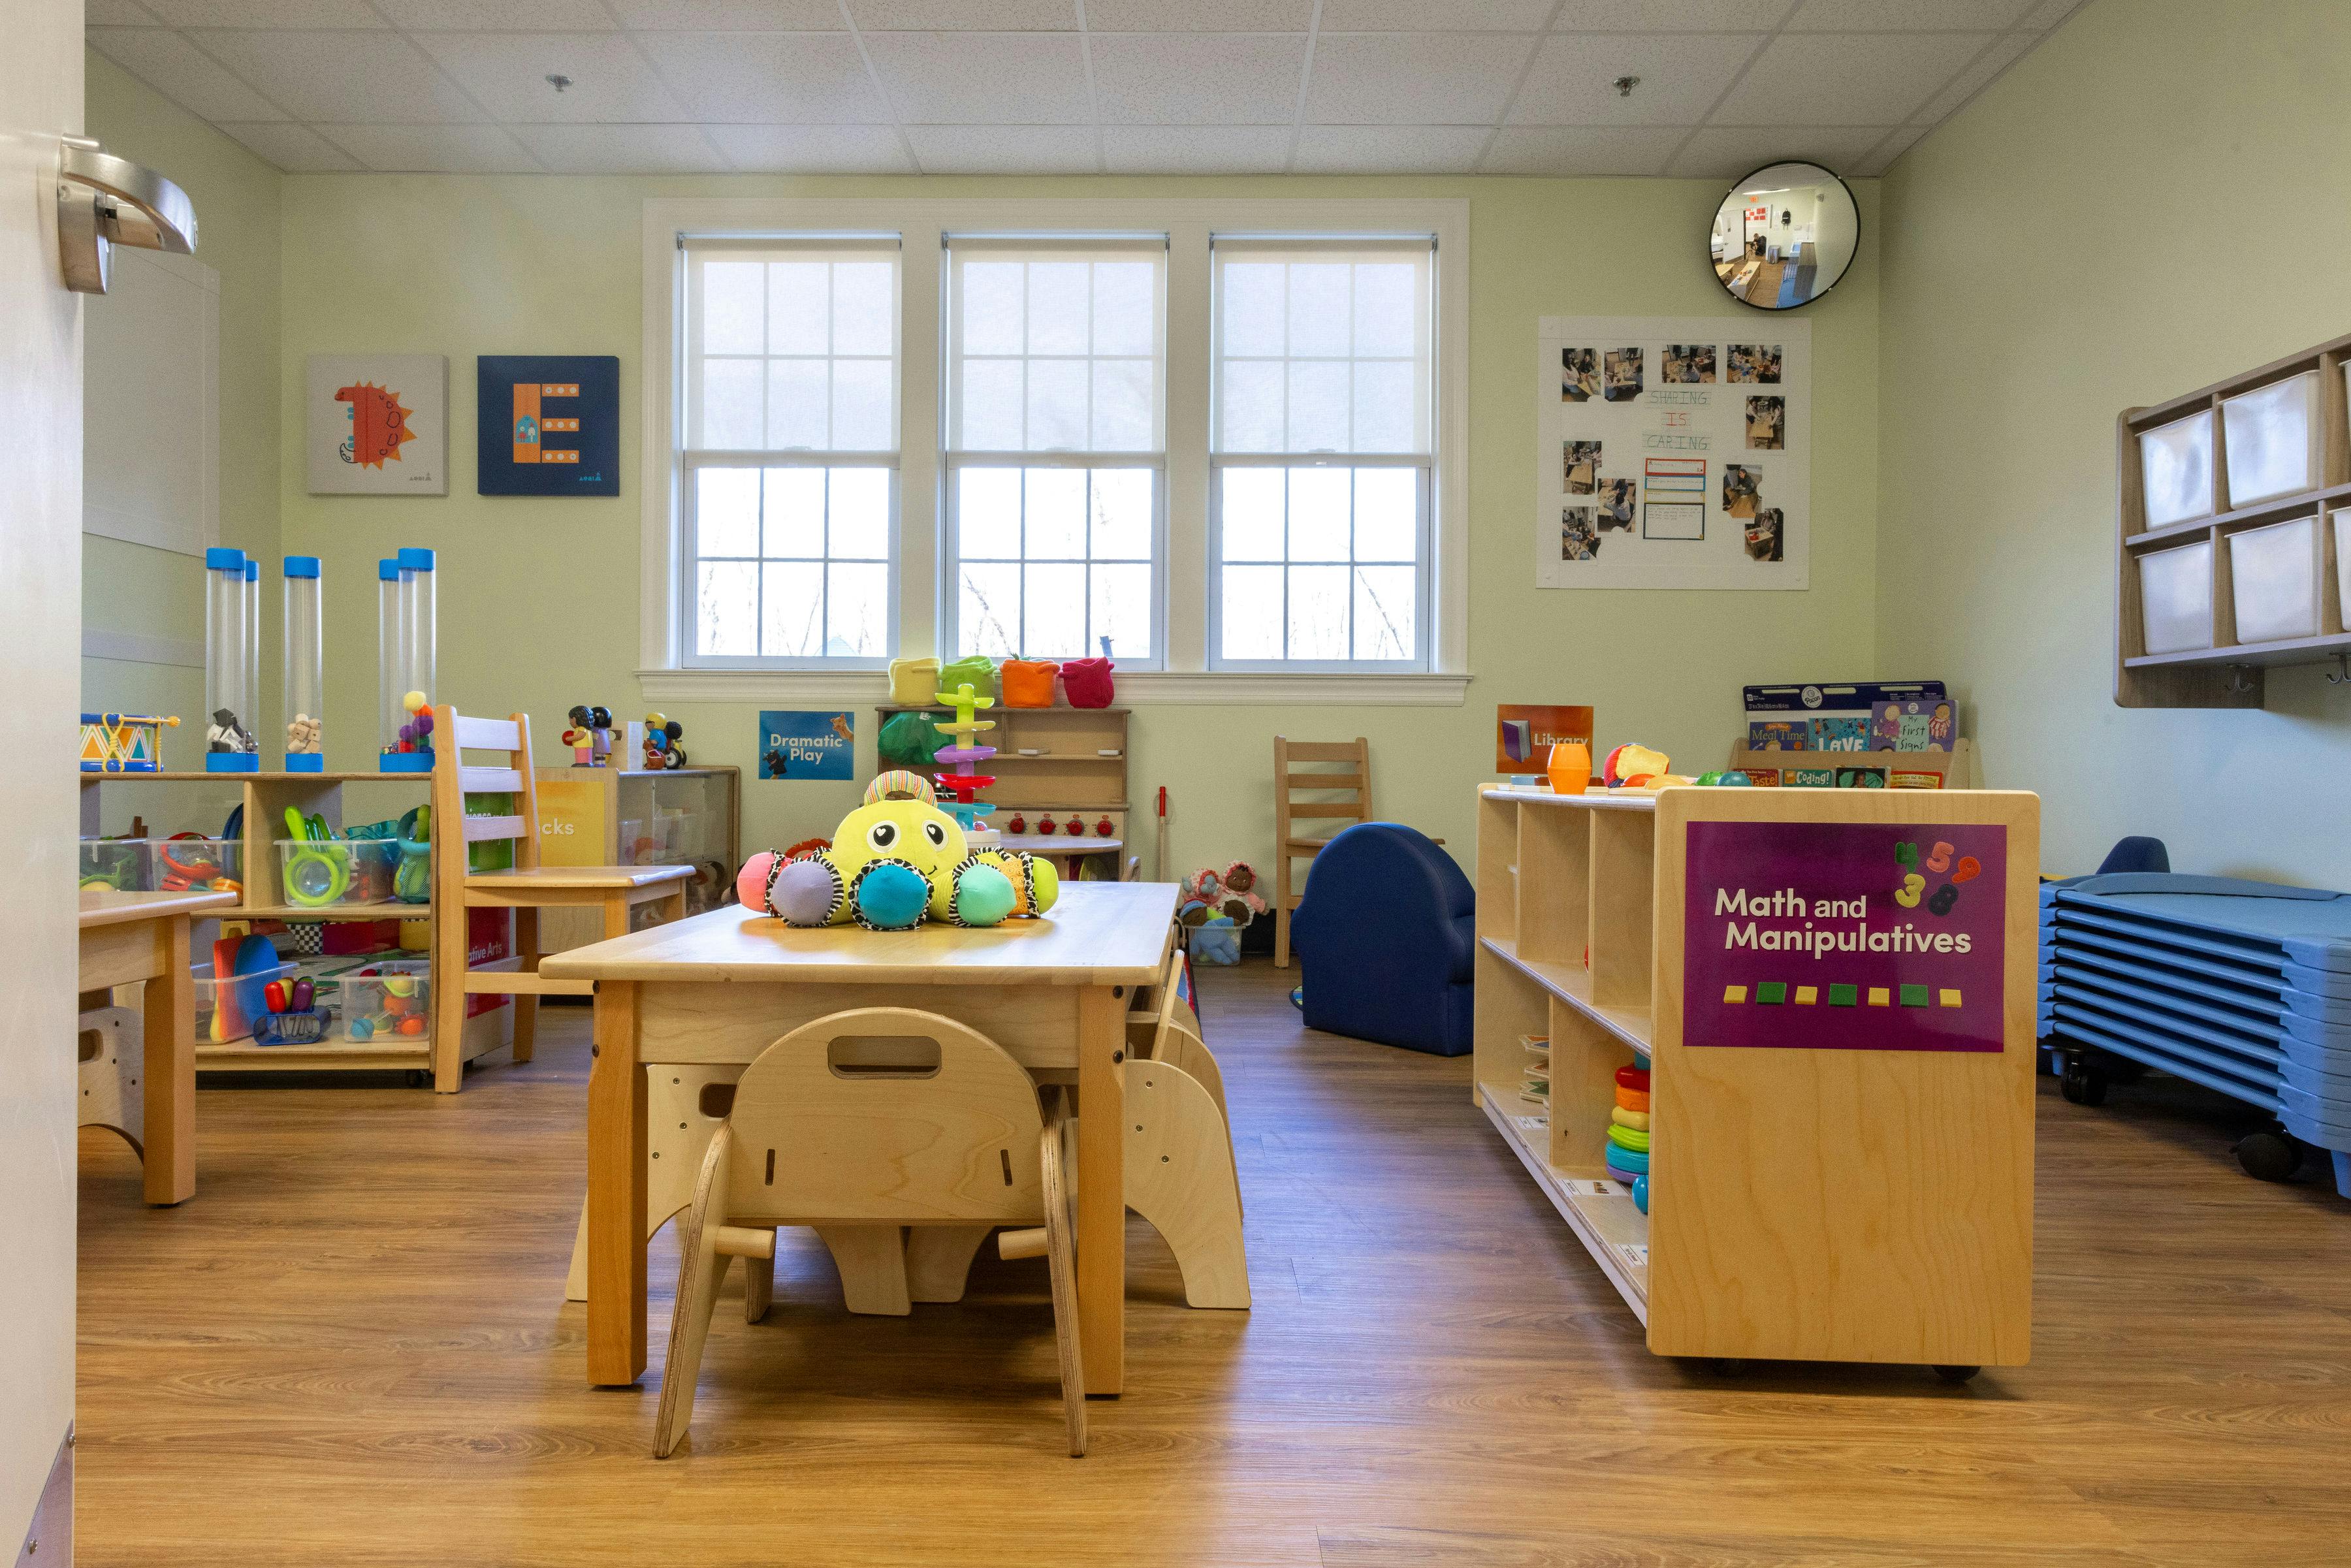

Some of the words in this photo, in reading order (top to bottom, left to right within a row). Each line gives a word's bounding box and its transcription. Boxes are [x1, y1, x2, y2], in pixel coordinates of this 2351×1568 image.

[1651, 391, 1707, 404] SHARING
[1666, 413, 1687, 426] IS
[1647, 435, 1708, 450] CARING
[771, 733, 843, 748] Dramatic
[1752, 729, 1777, 741] Meal
[1781, 729, 1805, 741] Time
[1900, 739, 1924, 752] Signs
[790, 748, 824, 765] Play
[1748, 773, 1778, 787] Taste!
[1797, 772, 1829, 785] Coding!
[1715, 888, 1806, 917] Math
[1814, 895, 1866, 918] and
[1725, 921, 1972, 960] Manipulatives
[487, 941, 502, 957] Arts
